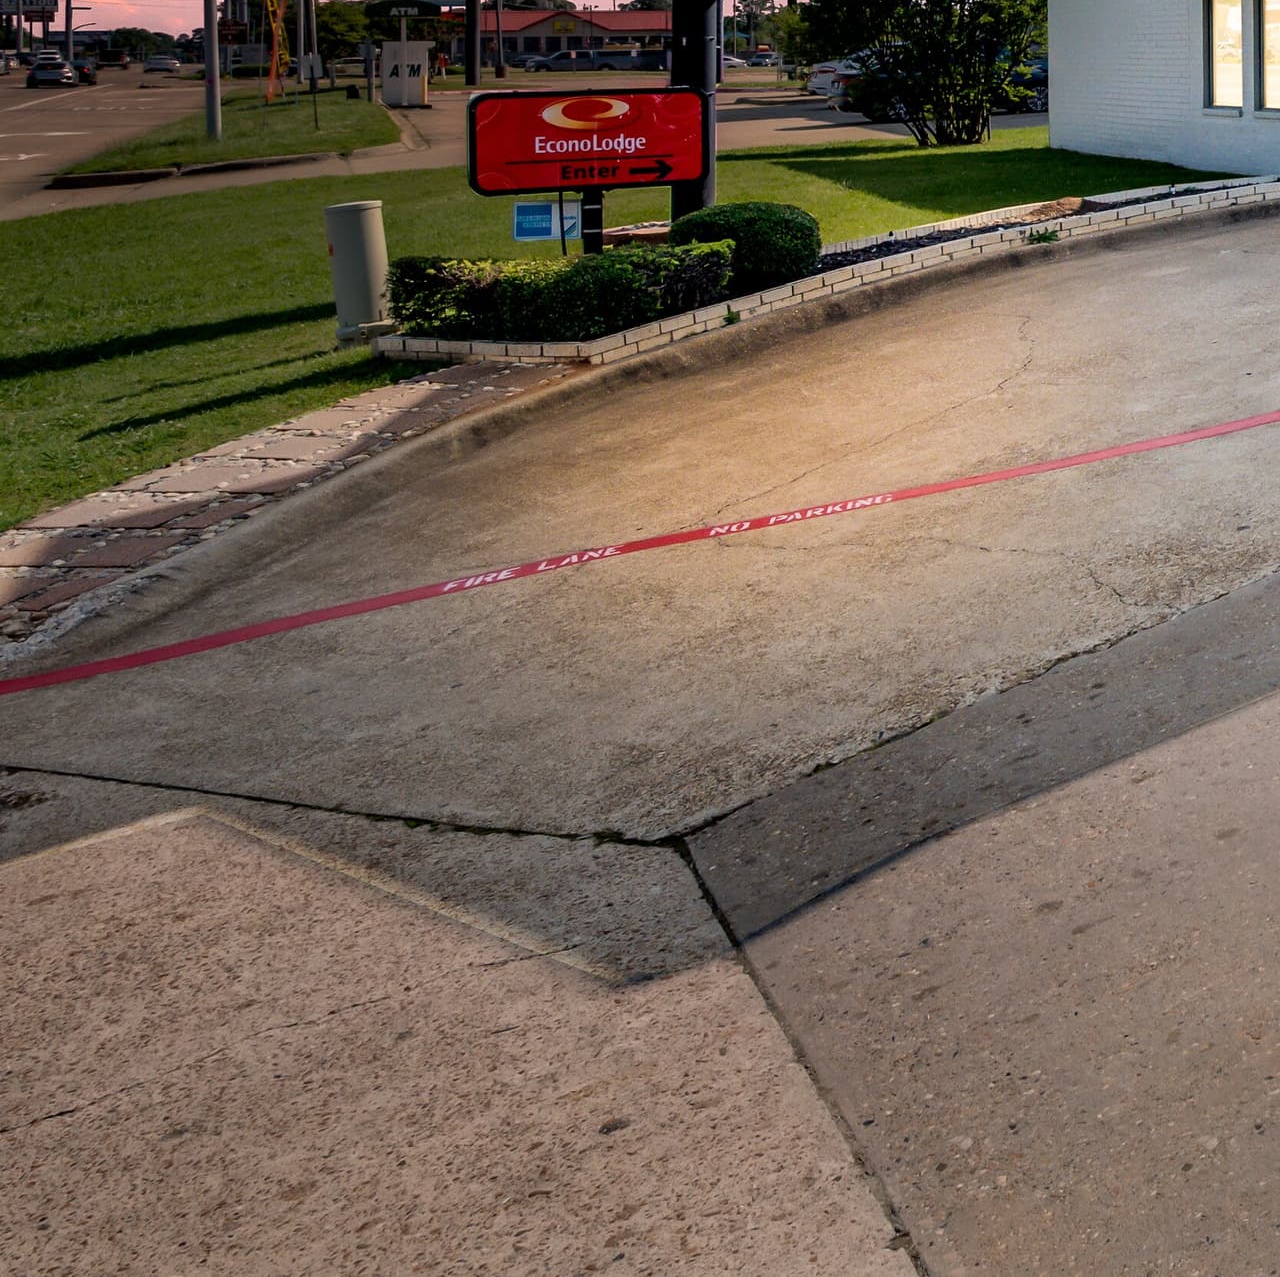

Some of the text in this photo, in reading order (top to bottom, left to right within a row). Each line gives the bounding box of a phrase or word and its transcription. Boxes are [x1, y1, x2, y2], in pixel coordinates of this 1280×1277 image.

[389, 6, 419, 16] ATM
[534, 133, 646, 154] EconoLodge
[561, 164, 620, 180] Enter
[443, 494, 893, 592] FIRE LANE NO PARKING
